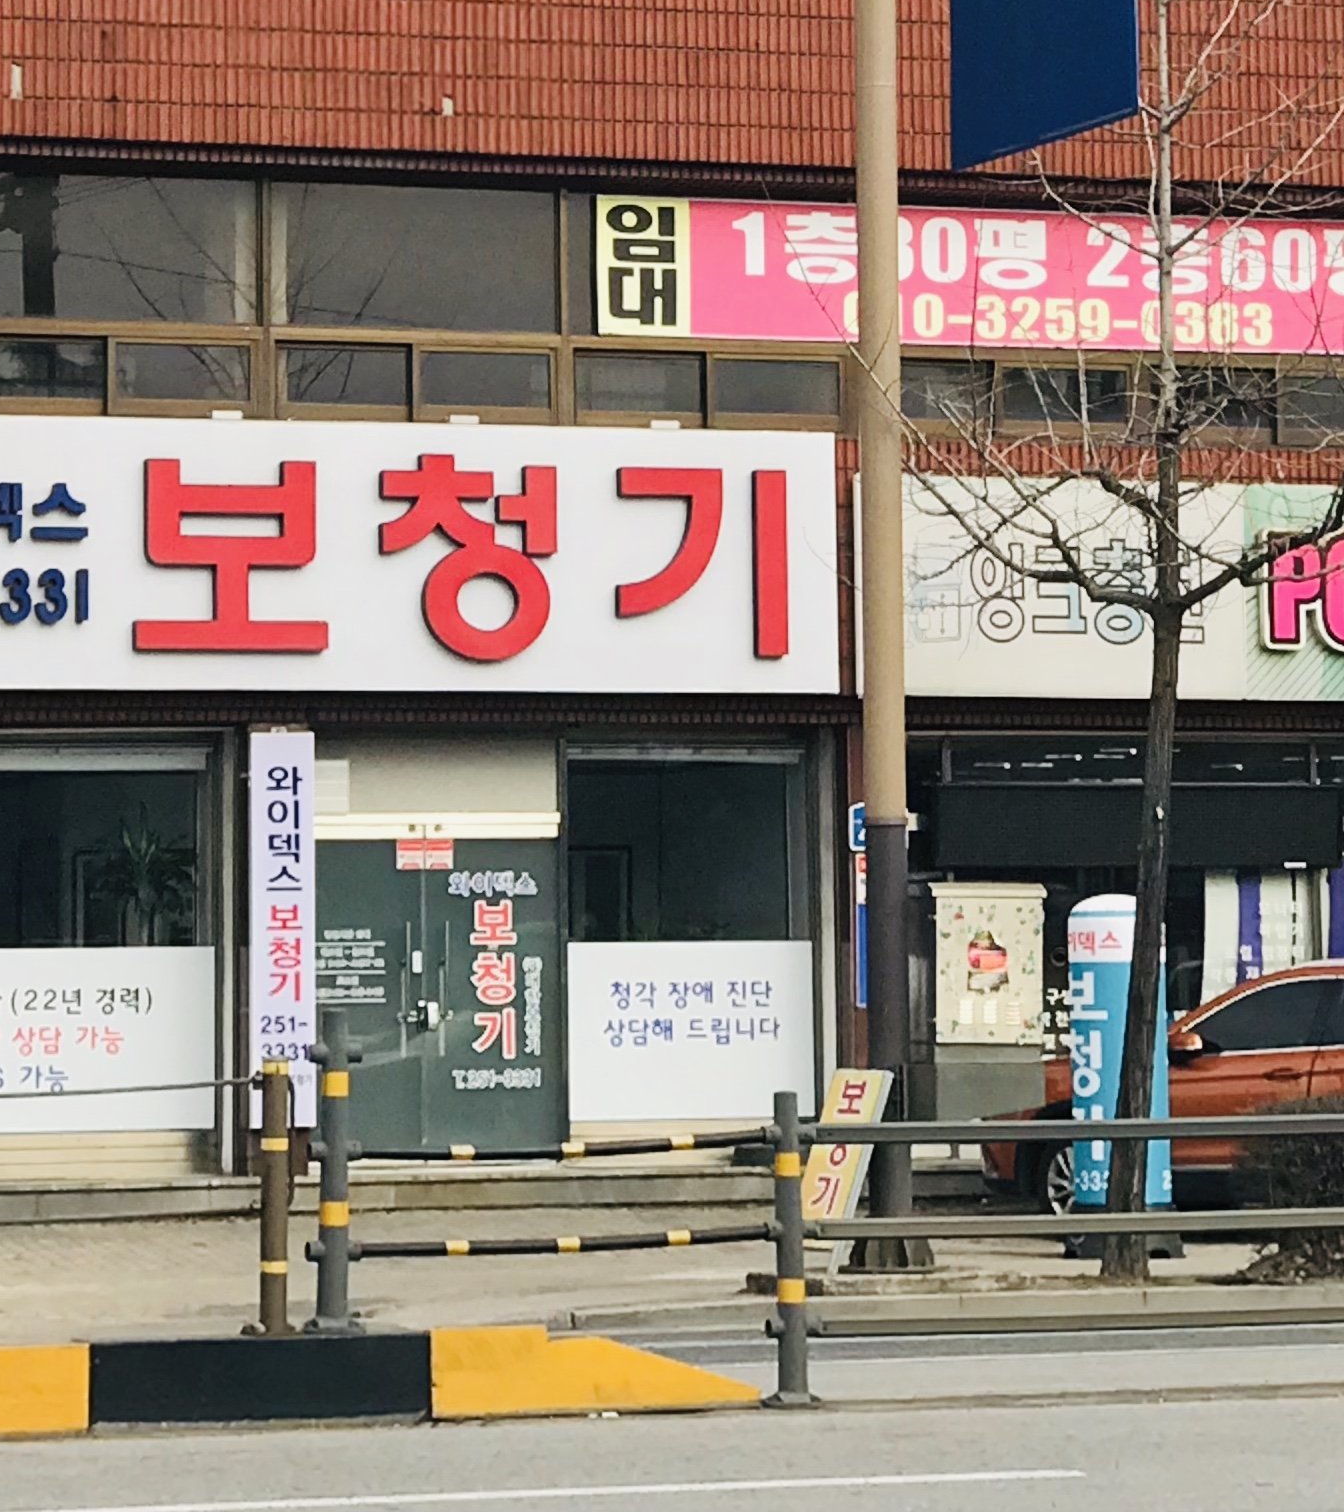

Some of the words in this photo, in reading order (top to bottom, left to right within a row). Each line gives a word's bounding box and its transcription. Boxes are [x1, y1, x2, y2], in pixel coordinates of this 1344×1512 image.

[604, 202, 678, 329] 임대
[842, 290, 1273, 348] 0-3259-0383
[131, 454, 790, 663] 보청기
[266, 765, 304, 892] 와이덱스
[268, 904, 302, 1002] 보청기
[470, 899, 517, 1060] 보청기
[603, 1020, 675, 1048] 상담해
[685, 1017, 782, 1044] 드립니다
[609, 981, 658, 1009] 청각
[668, 980, 716, 1008] 장애
[725, 980, 774, 1008] 진단
[10, 1026, 63, 1057] 상담
[74, 1024, 126, 1055] 가능
[18, 1064, 70, 1094] 가능
